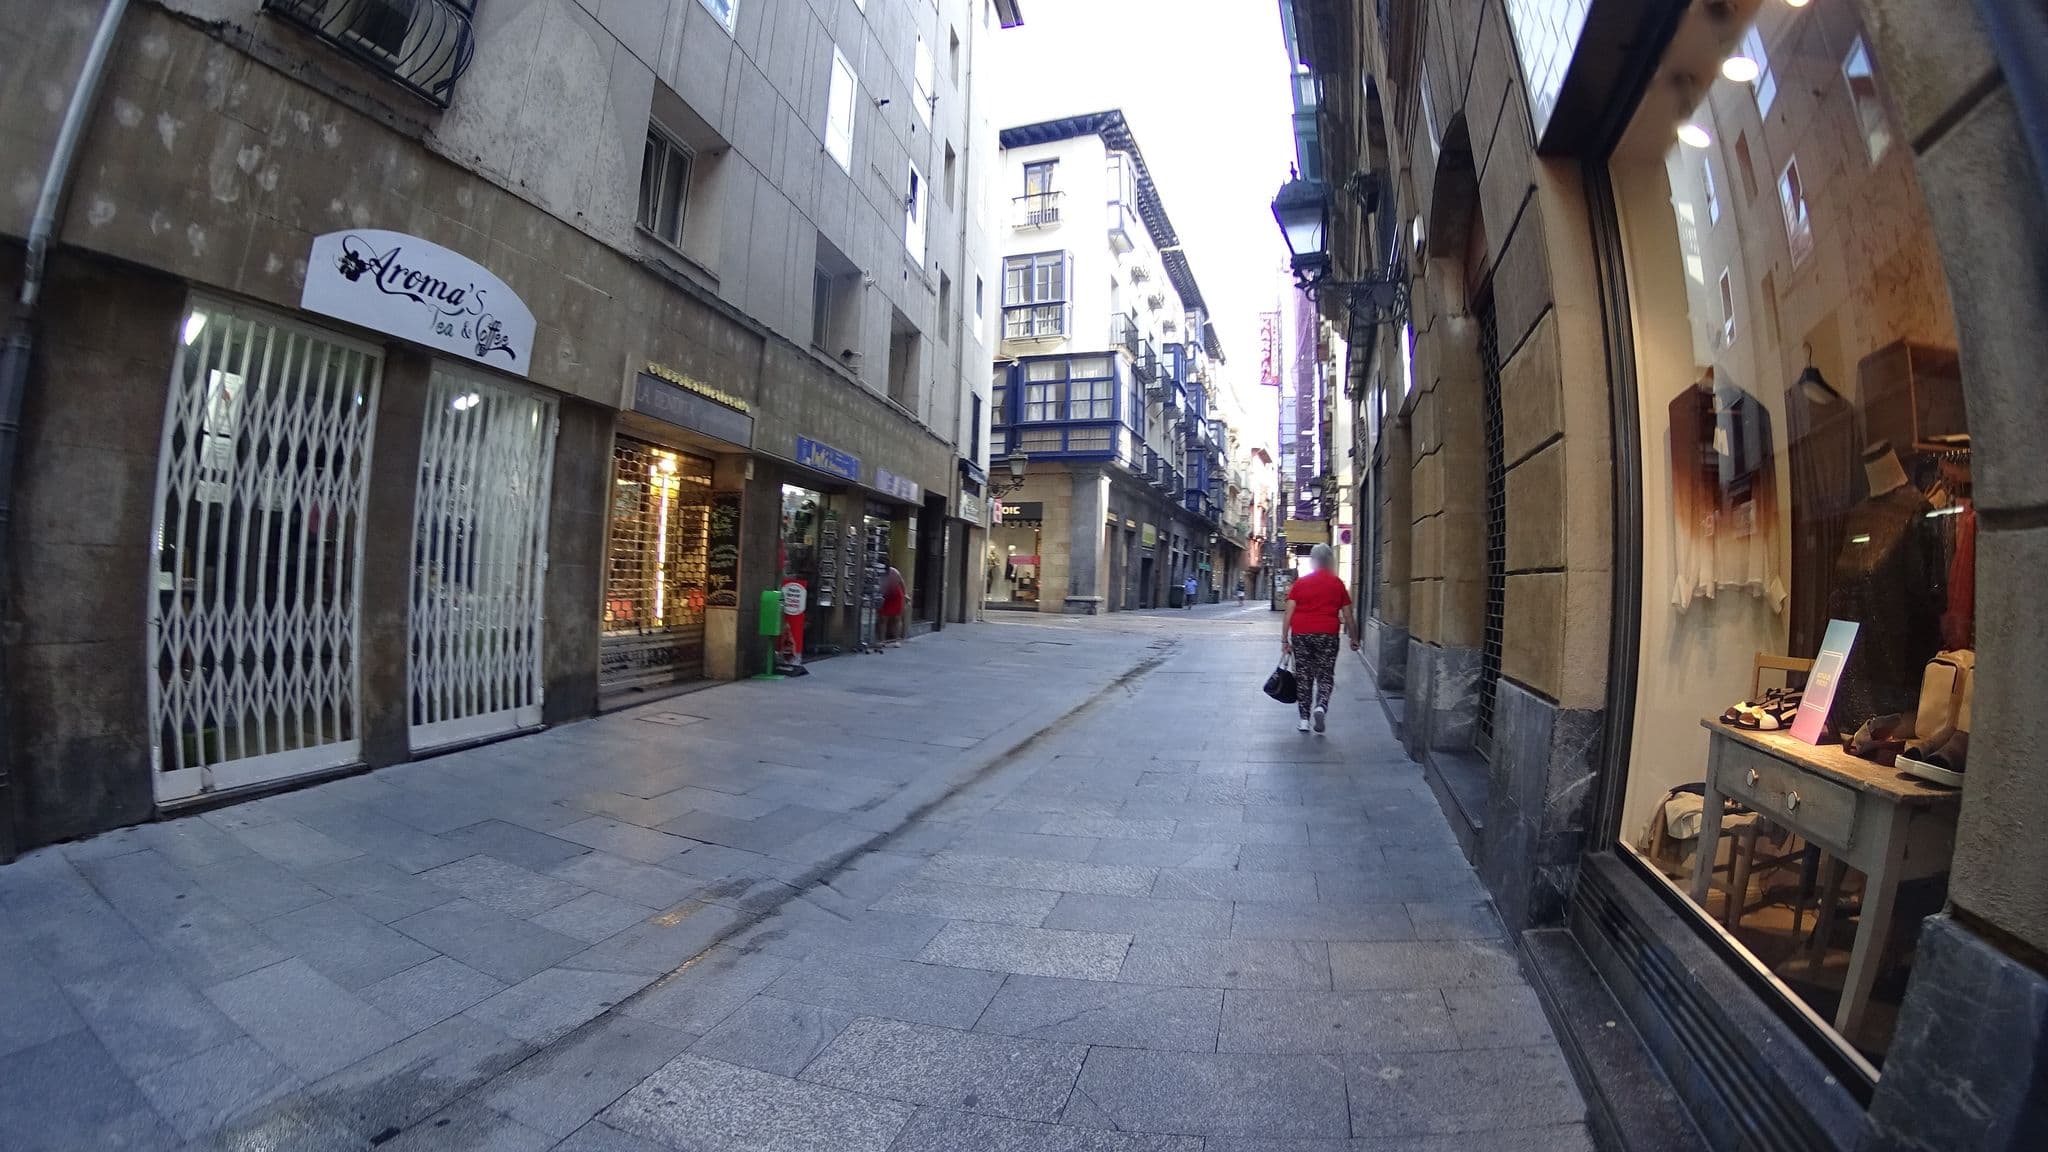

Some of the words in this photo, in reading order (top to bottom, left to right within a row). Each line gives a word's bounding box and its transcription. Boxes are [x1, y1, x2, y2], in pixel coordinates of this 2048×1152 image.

[428, 304, 454, 338] Tea
[461, 321, 472, 340] &
[475, 313, 512, 356] Coffee
